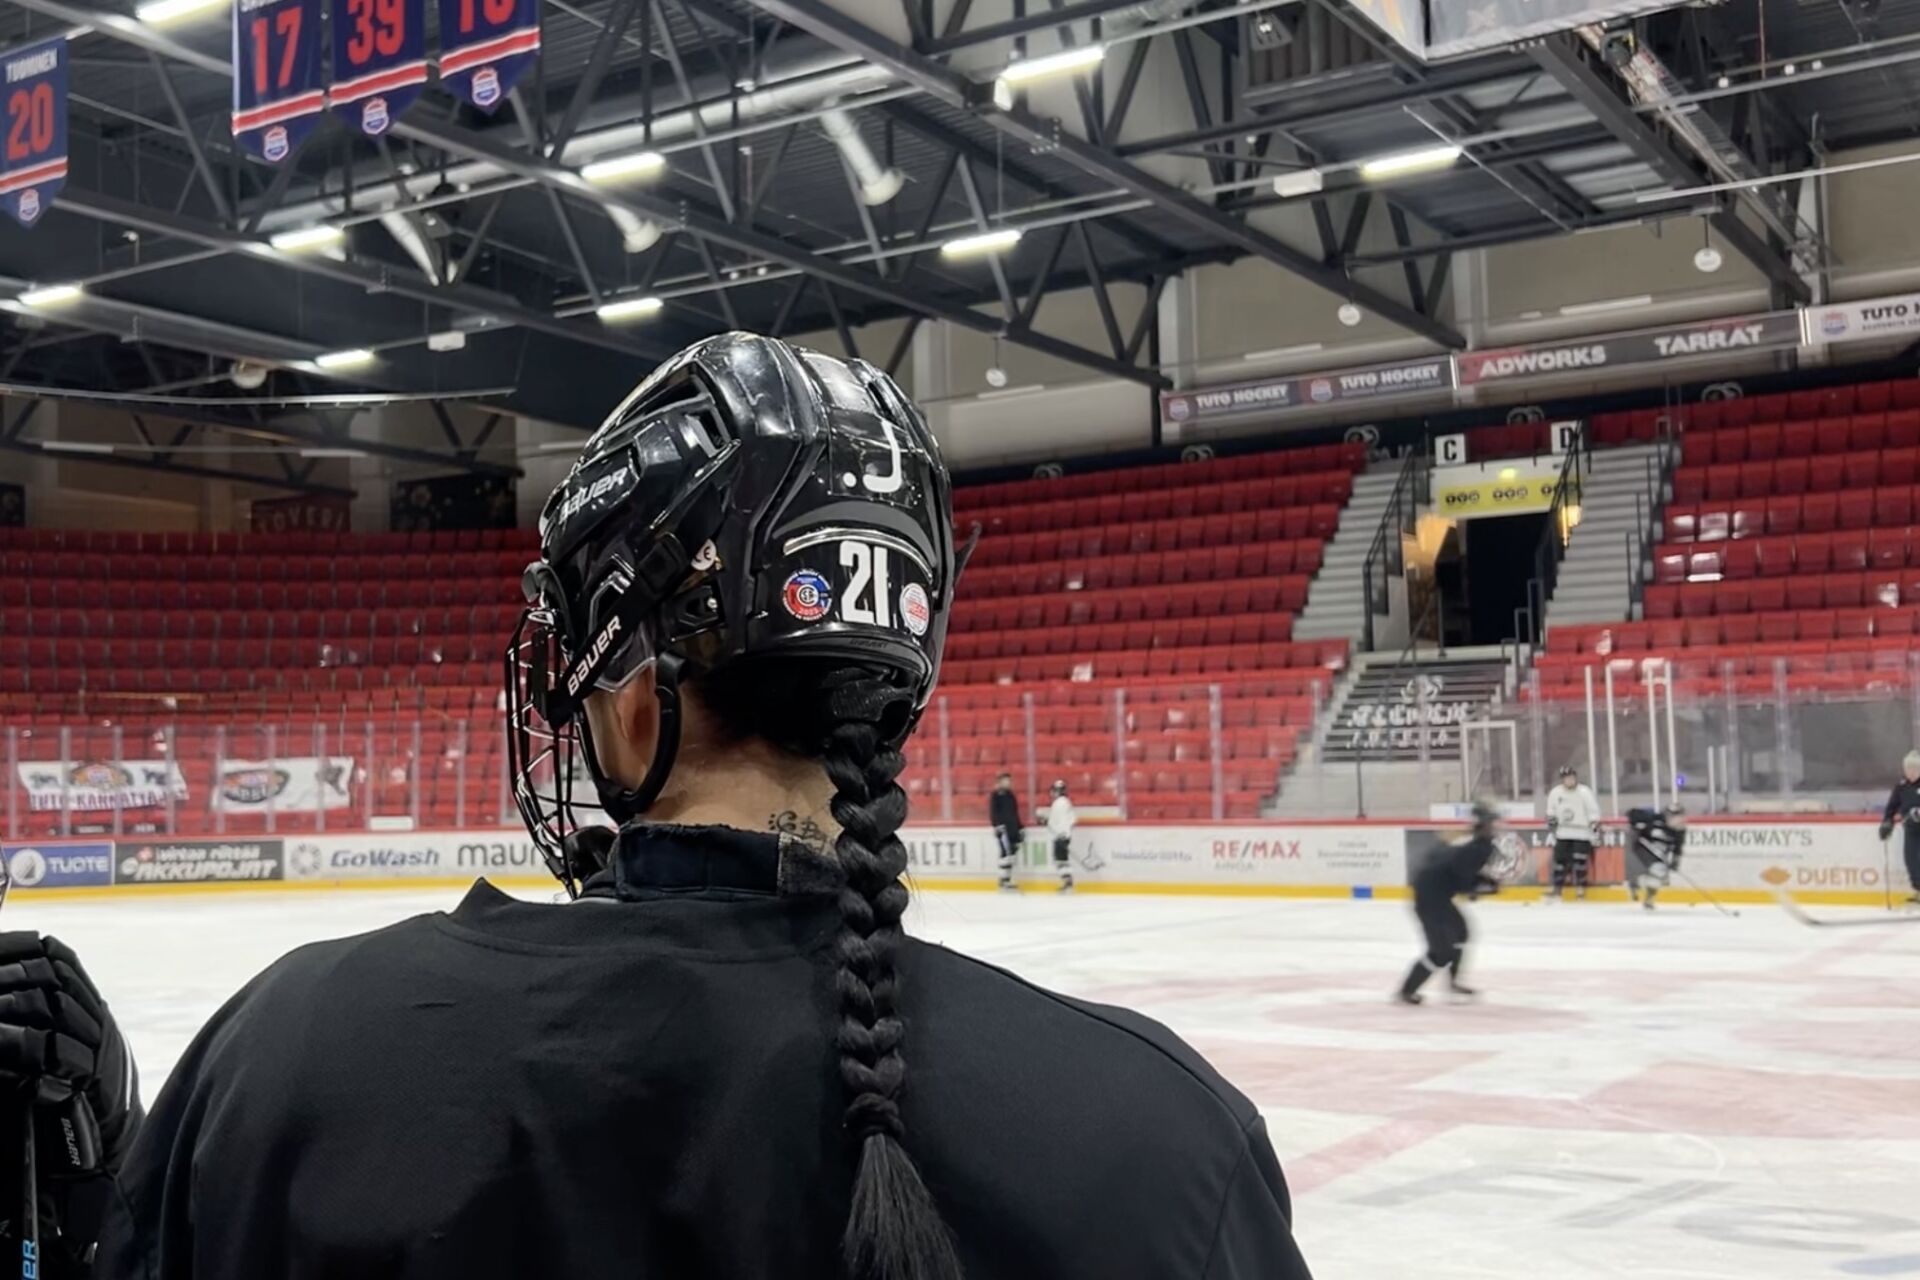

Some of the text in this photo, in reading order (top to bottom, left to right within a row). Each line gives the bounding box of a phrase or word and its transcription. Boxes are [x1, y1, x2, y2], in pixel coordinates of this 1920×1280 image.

[348, 0, 406, 65] 39
[252, 6, 303, 95] 17
[7, 83, 54, 160] 20
[1860, 304, 1908, 320] TUTO
[1654, 325, 1764, 356] TARRAT
[1479, 345, 1606, 378] ADWORKS
[1340, 373, 1377, 390] TUTO
[1380, 364, 1440, 385] HOCKEY
[1196, 392, 1230, 409] TUTO
[1233, 384, 1288, 403] HOCKEY
[1443, 440, 1457, 461] C
[839, 540, 891, 628] 21
[1212, 839, 1302, 860] RE/MAX
[1686, 829, 1814, 848] EMINGWAY'S
[49, 855, 111, 875] TUOTE
[330, 849, 440, 868] GoWash
[1796, 867, 1880, 886] DUETTO
